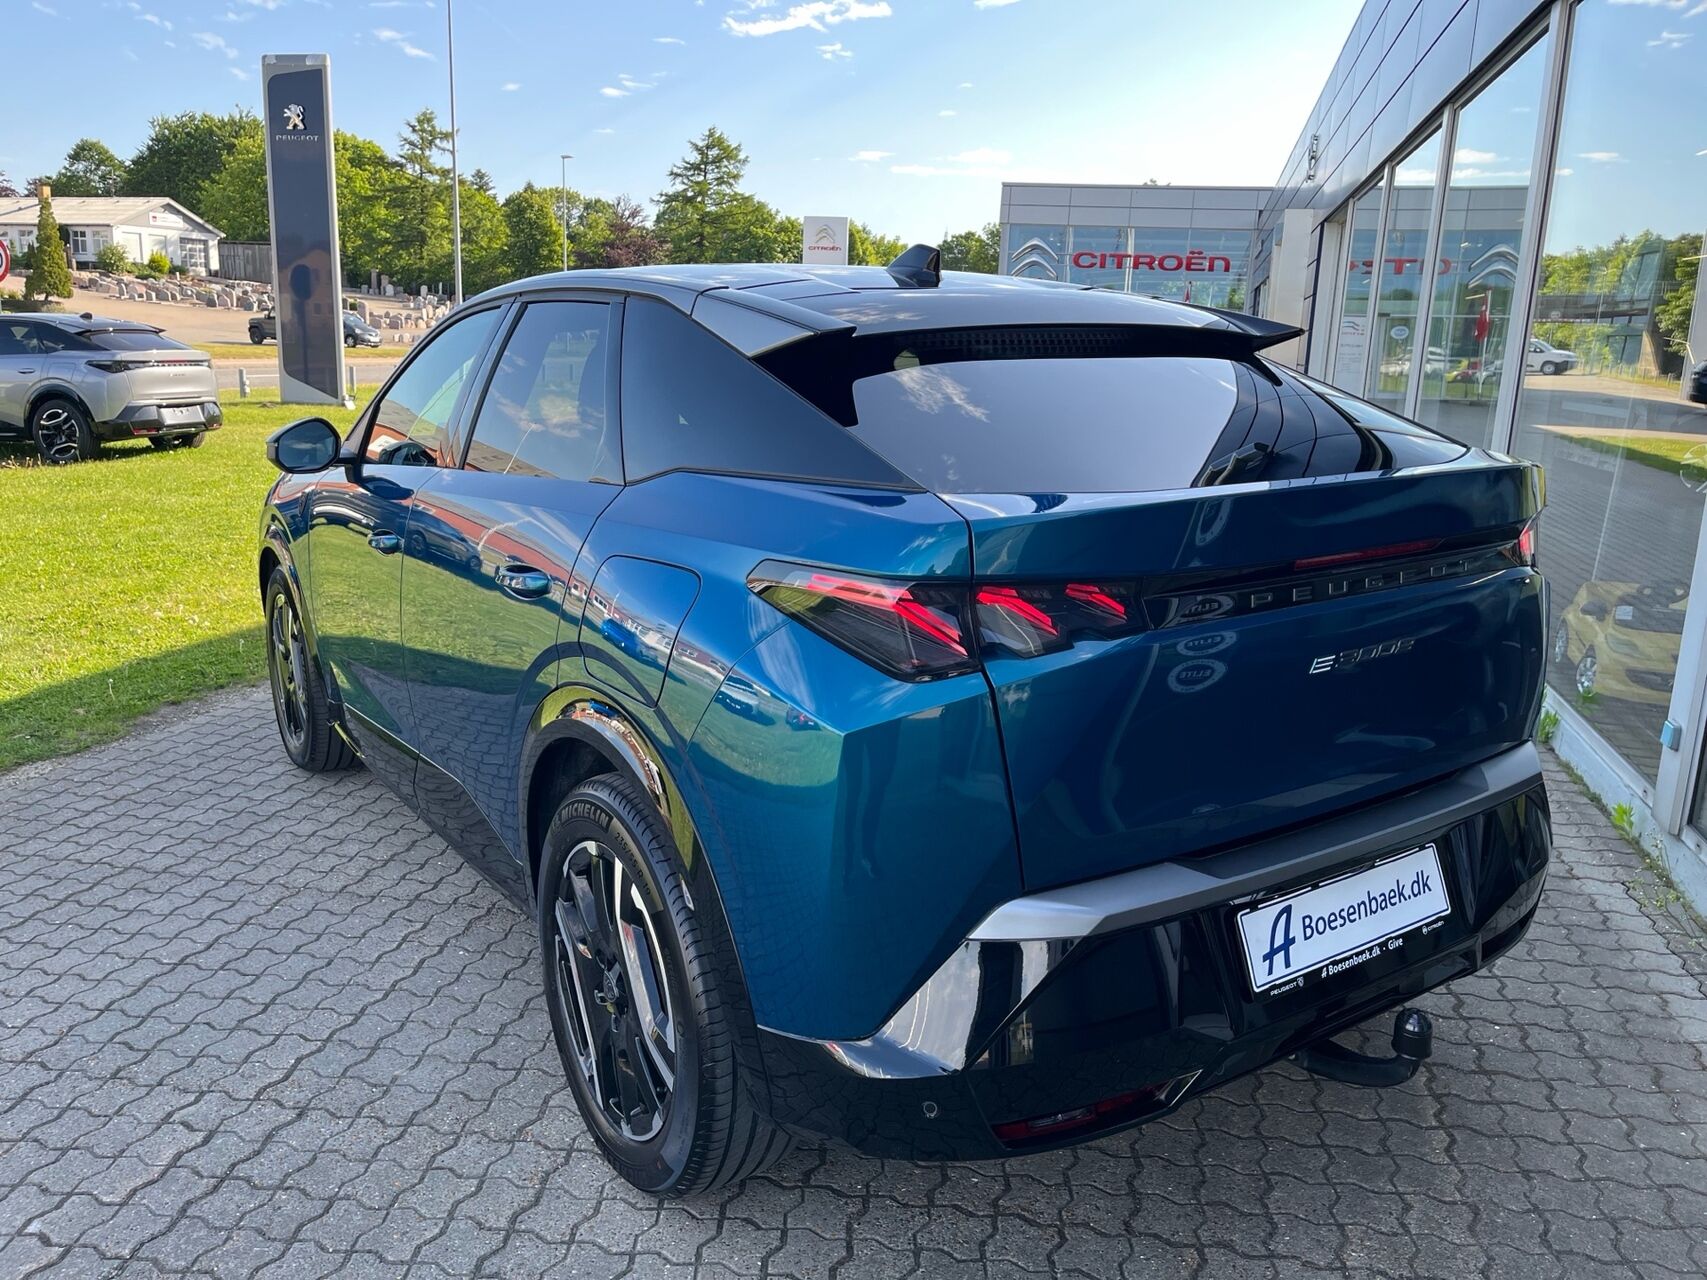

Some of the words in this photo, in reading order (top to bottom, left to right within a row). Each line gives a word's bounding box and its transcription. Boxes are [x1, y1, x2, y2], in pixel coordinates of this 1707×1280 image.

[275, 134, 319, 142] PEUGEOT
[1072, 250, 1231, 273] CITROËN
[1251, 559, 1469, 609] PEUGEOT
[561, 802, 610, 829] MICHELIN
[614, 831, 639, 868] 235/55
[1301, 869, 1433, 942] Boesenbaek.dk
[1328, 945, 1381, 976] Boesenbaek.dk
[1387, 937, 1404, 951] Give
[1270, 981, 1297, 996] PEUGEOT
